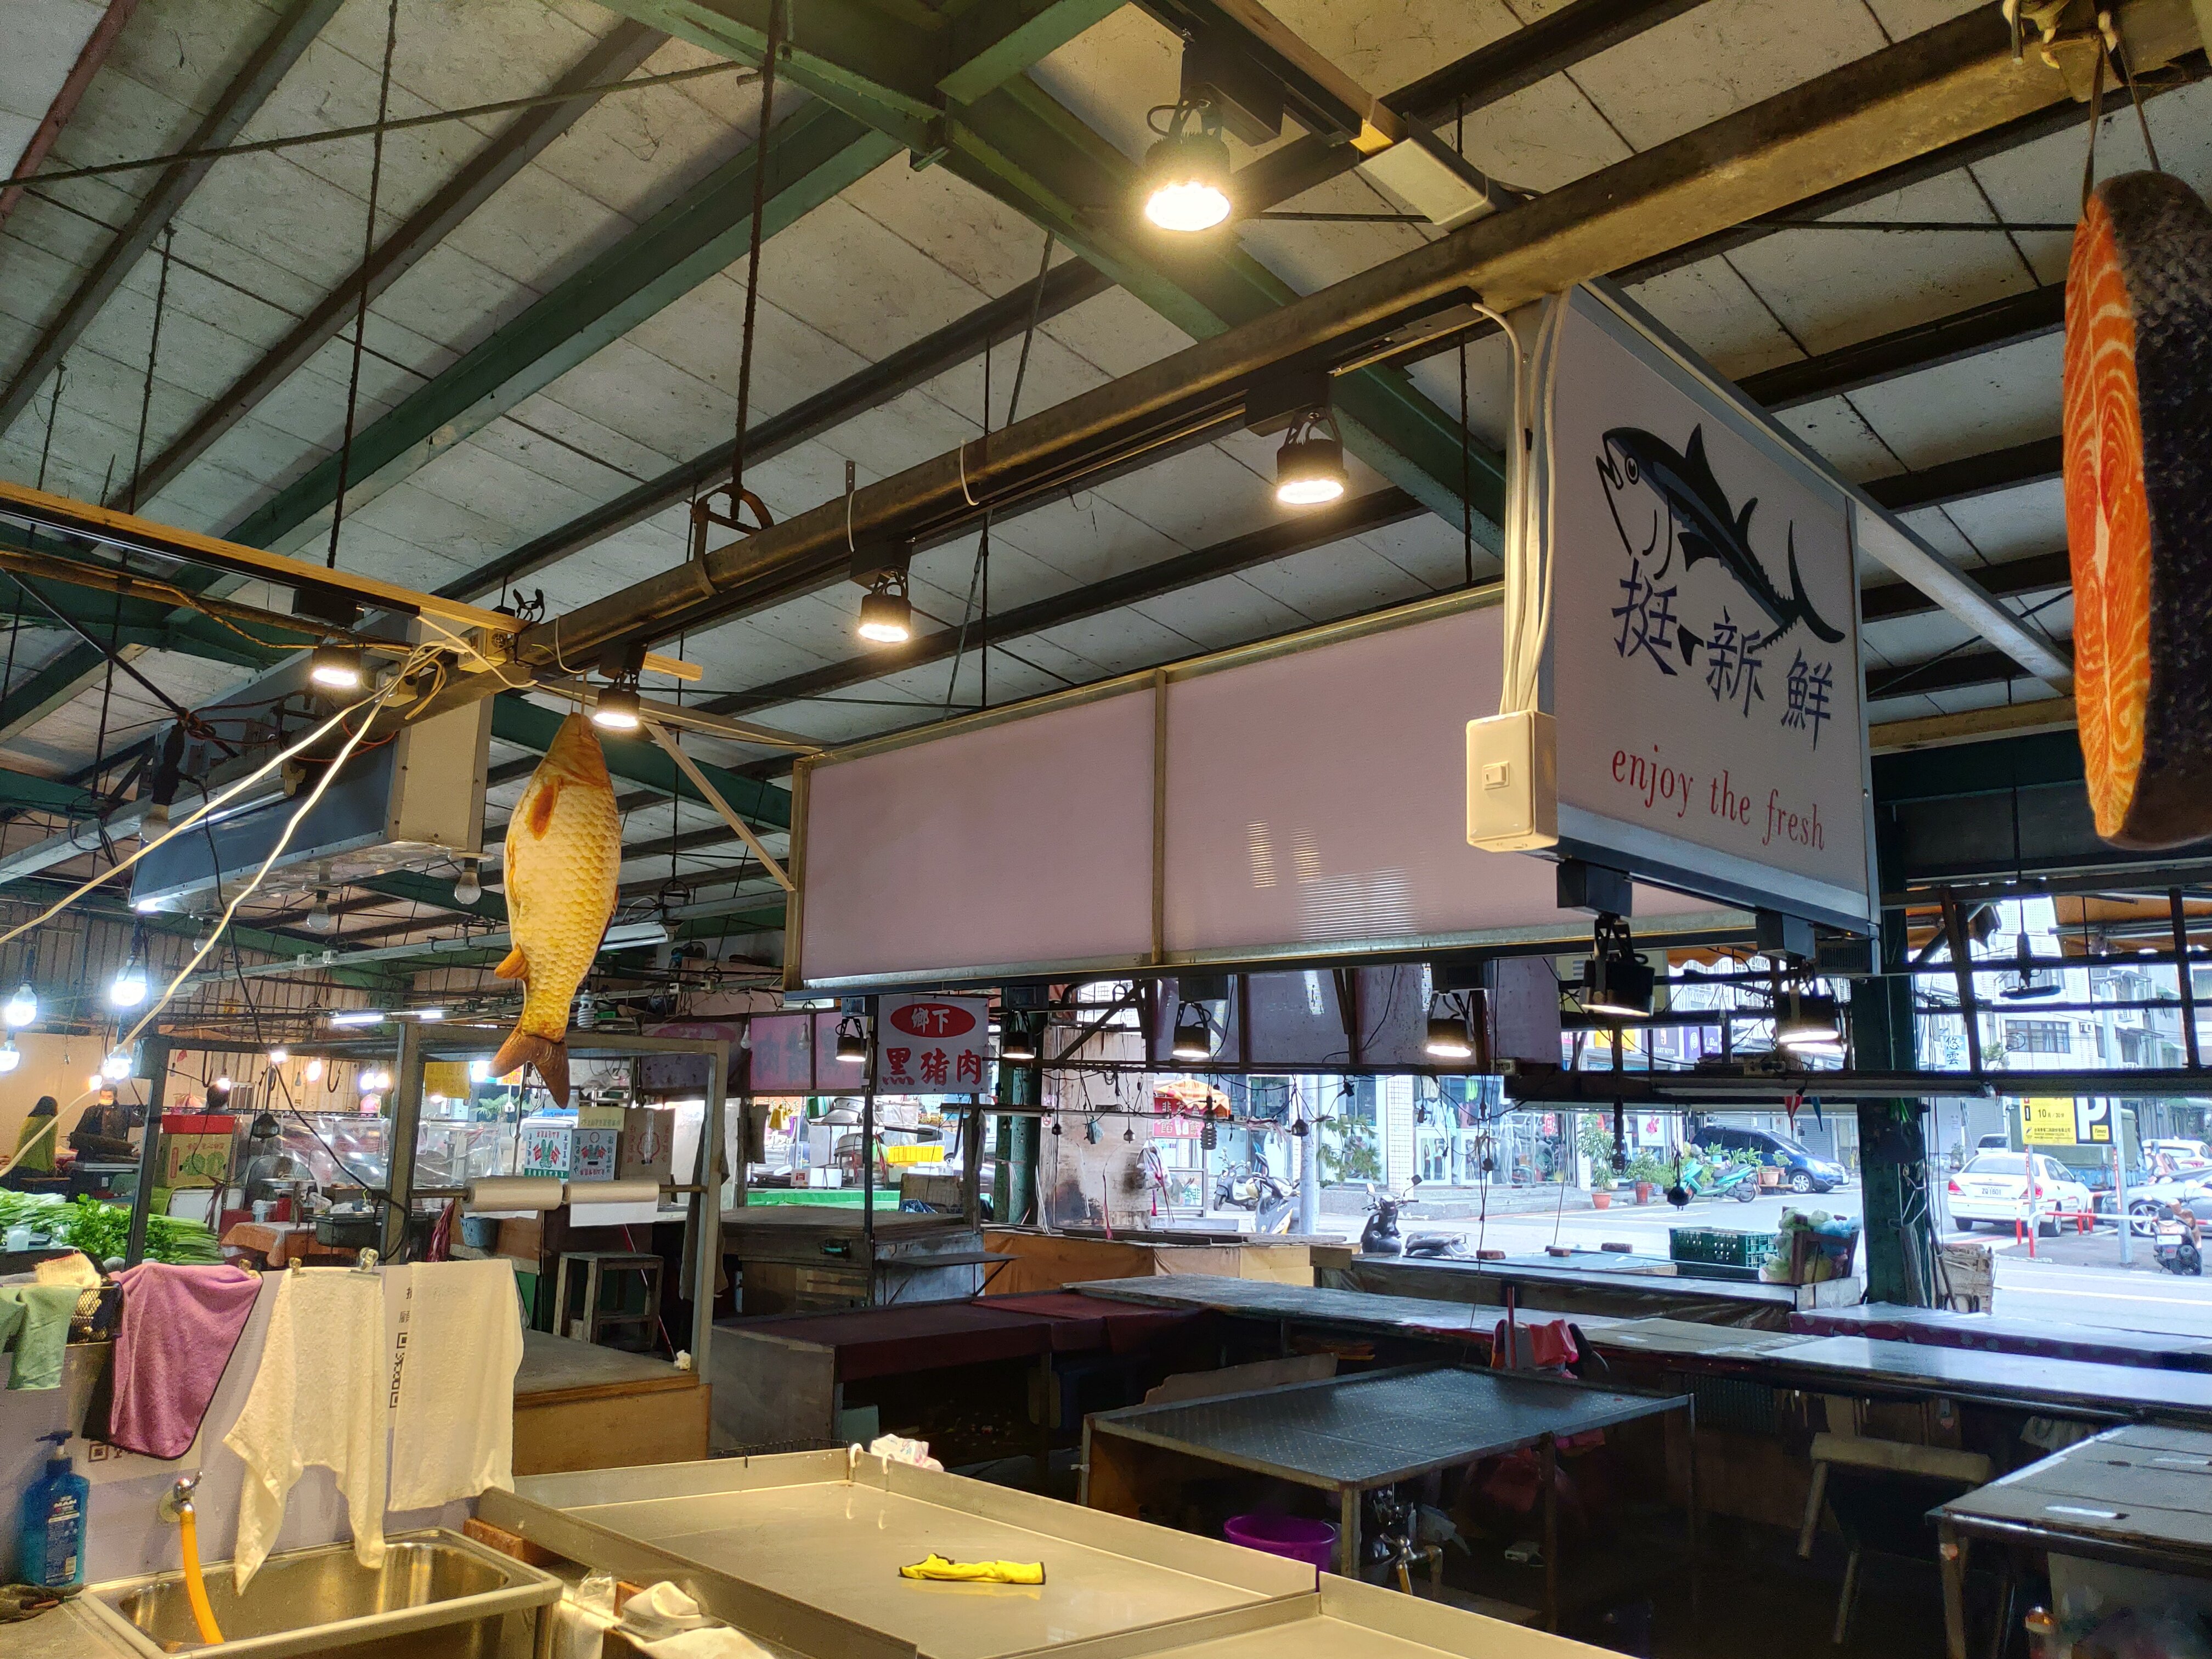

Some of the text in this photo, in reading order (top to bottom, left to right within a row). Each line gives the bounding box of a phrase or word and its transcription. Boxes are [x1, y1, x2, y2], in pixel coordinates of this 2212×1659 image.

[1611, 557, 1833, 751] 挺新鮮
[1612, 744, 1825, 850] enjoy the fresh
[911, 1007, 950, 1034] 鄉下
[882, 1047, 982, 1086] 黑豬肉
[1946, 1036, 1960, 1065] 悠雲
